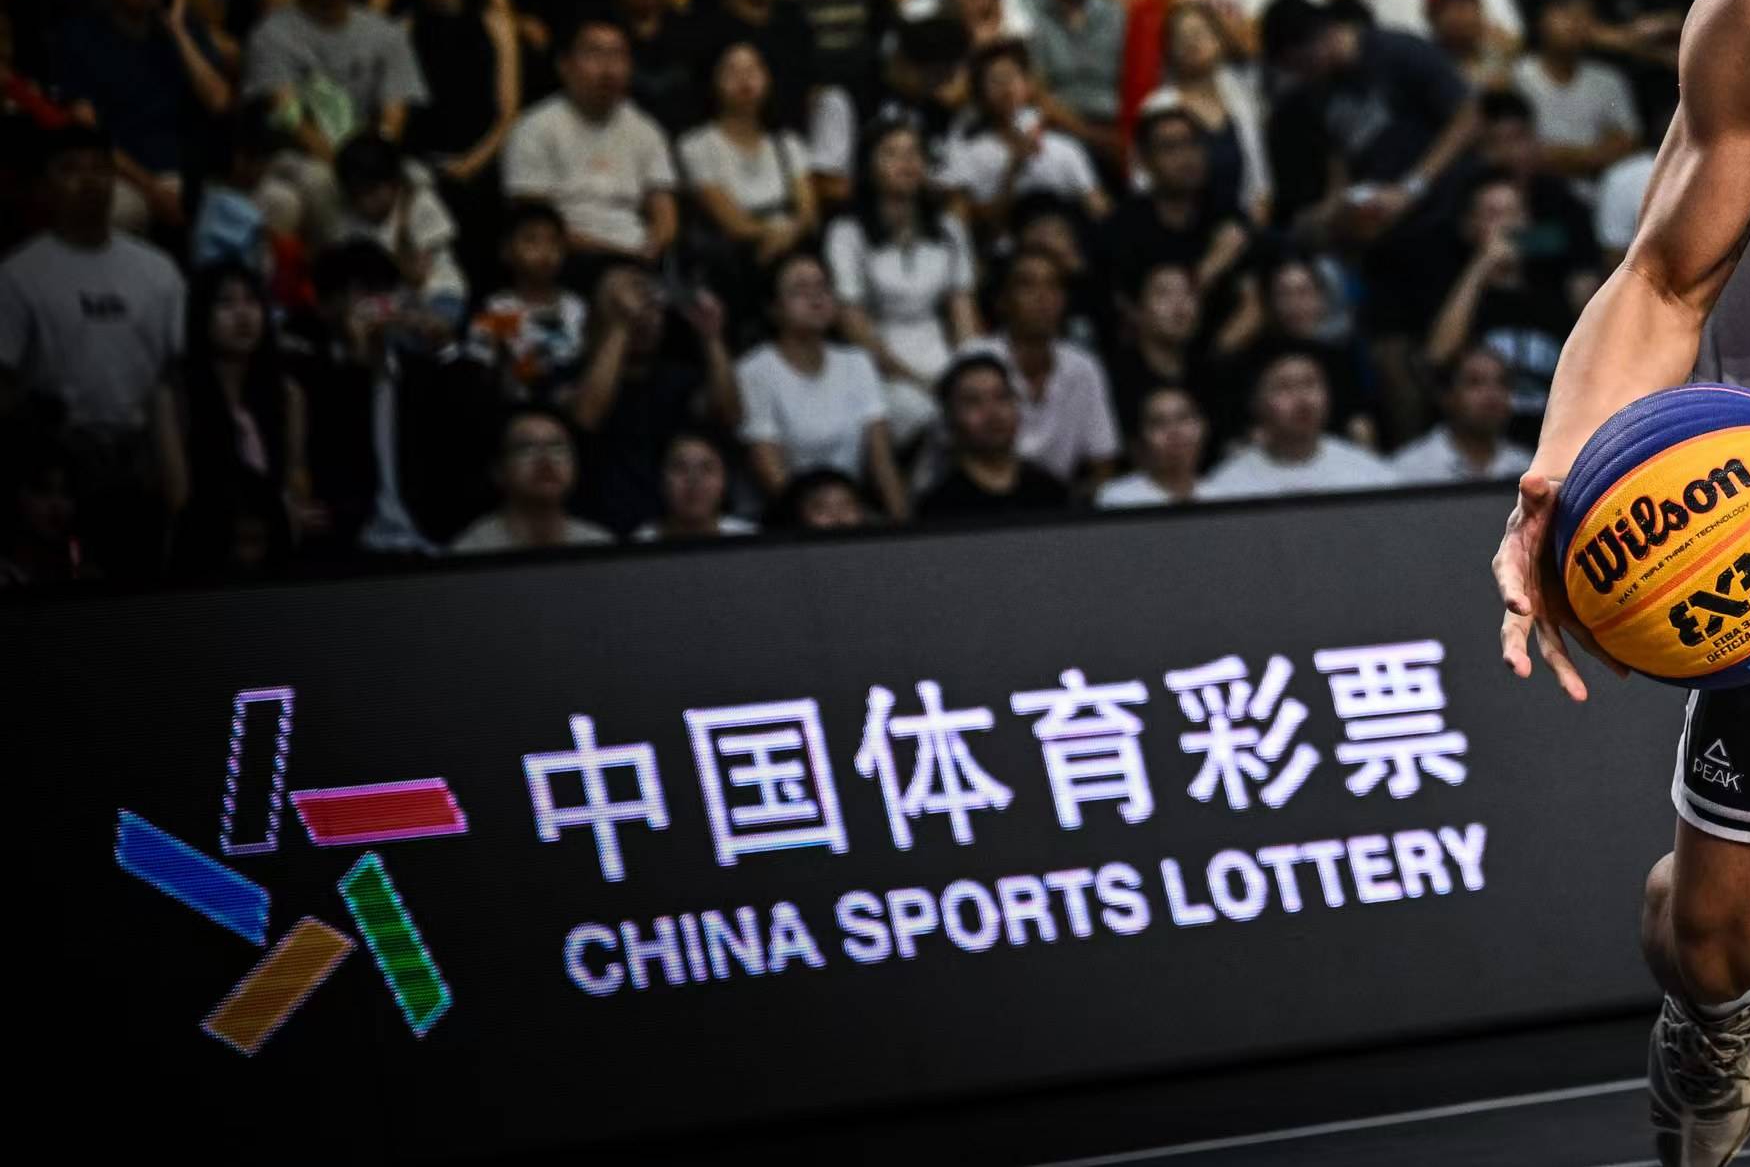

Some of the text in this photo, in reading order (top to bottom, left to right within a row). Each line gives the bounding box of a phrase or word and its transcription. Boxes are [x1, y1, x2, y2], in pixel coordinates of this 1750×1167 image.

[1664, 537, 1695, 562] THREAT
[1695, 502, 1750, 539] TECHNOLOGY
[1711, 627, 1741, 649] FIBA
[521, 639, 1470, 882] 中国体育彩票
[1692, 757, 1743, 792] PEAK
[562, 822, 1488, 998] CHINA SPORTS LOTTERY
